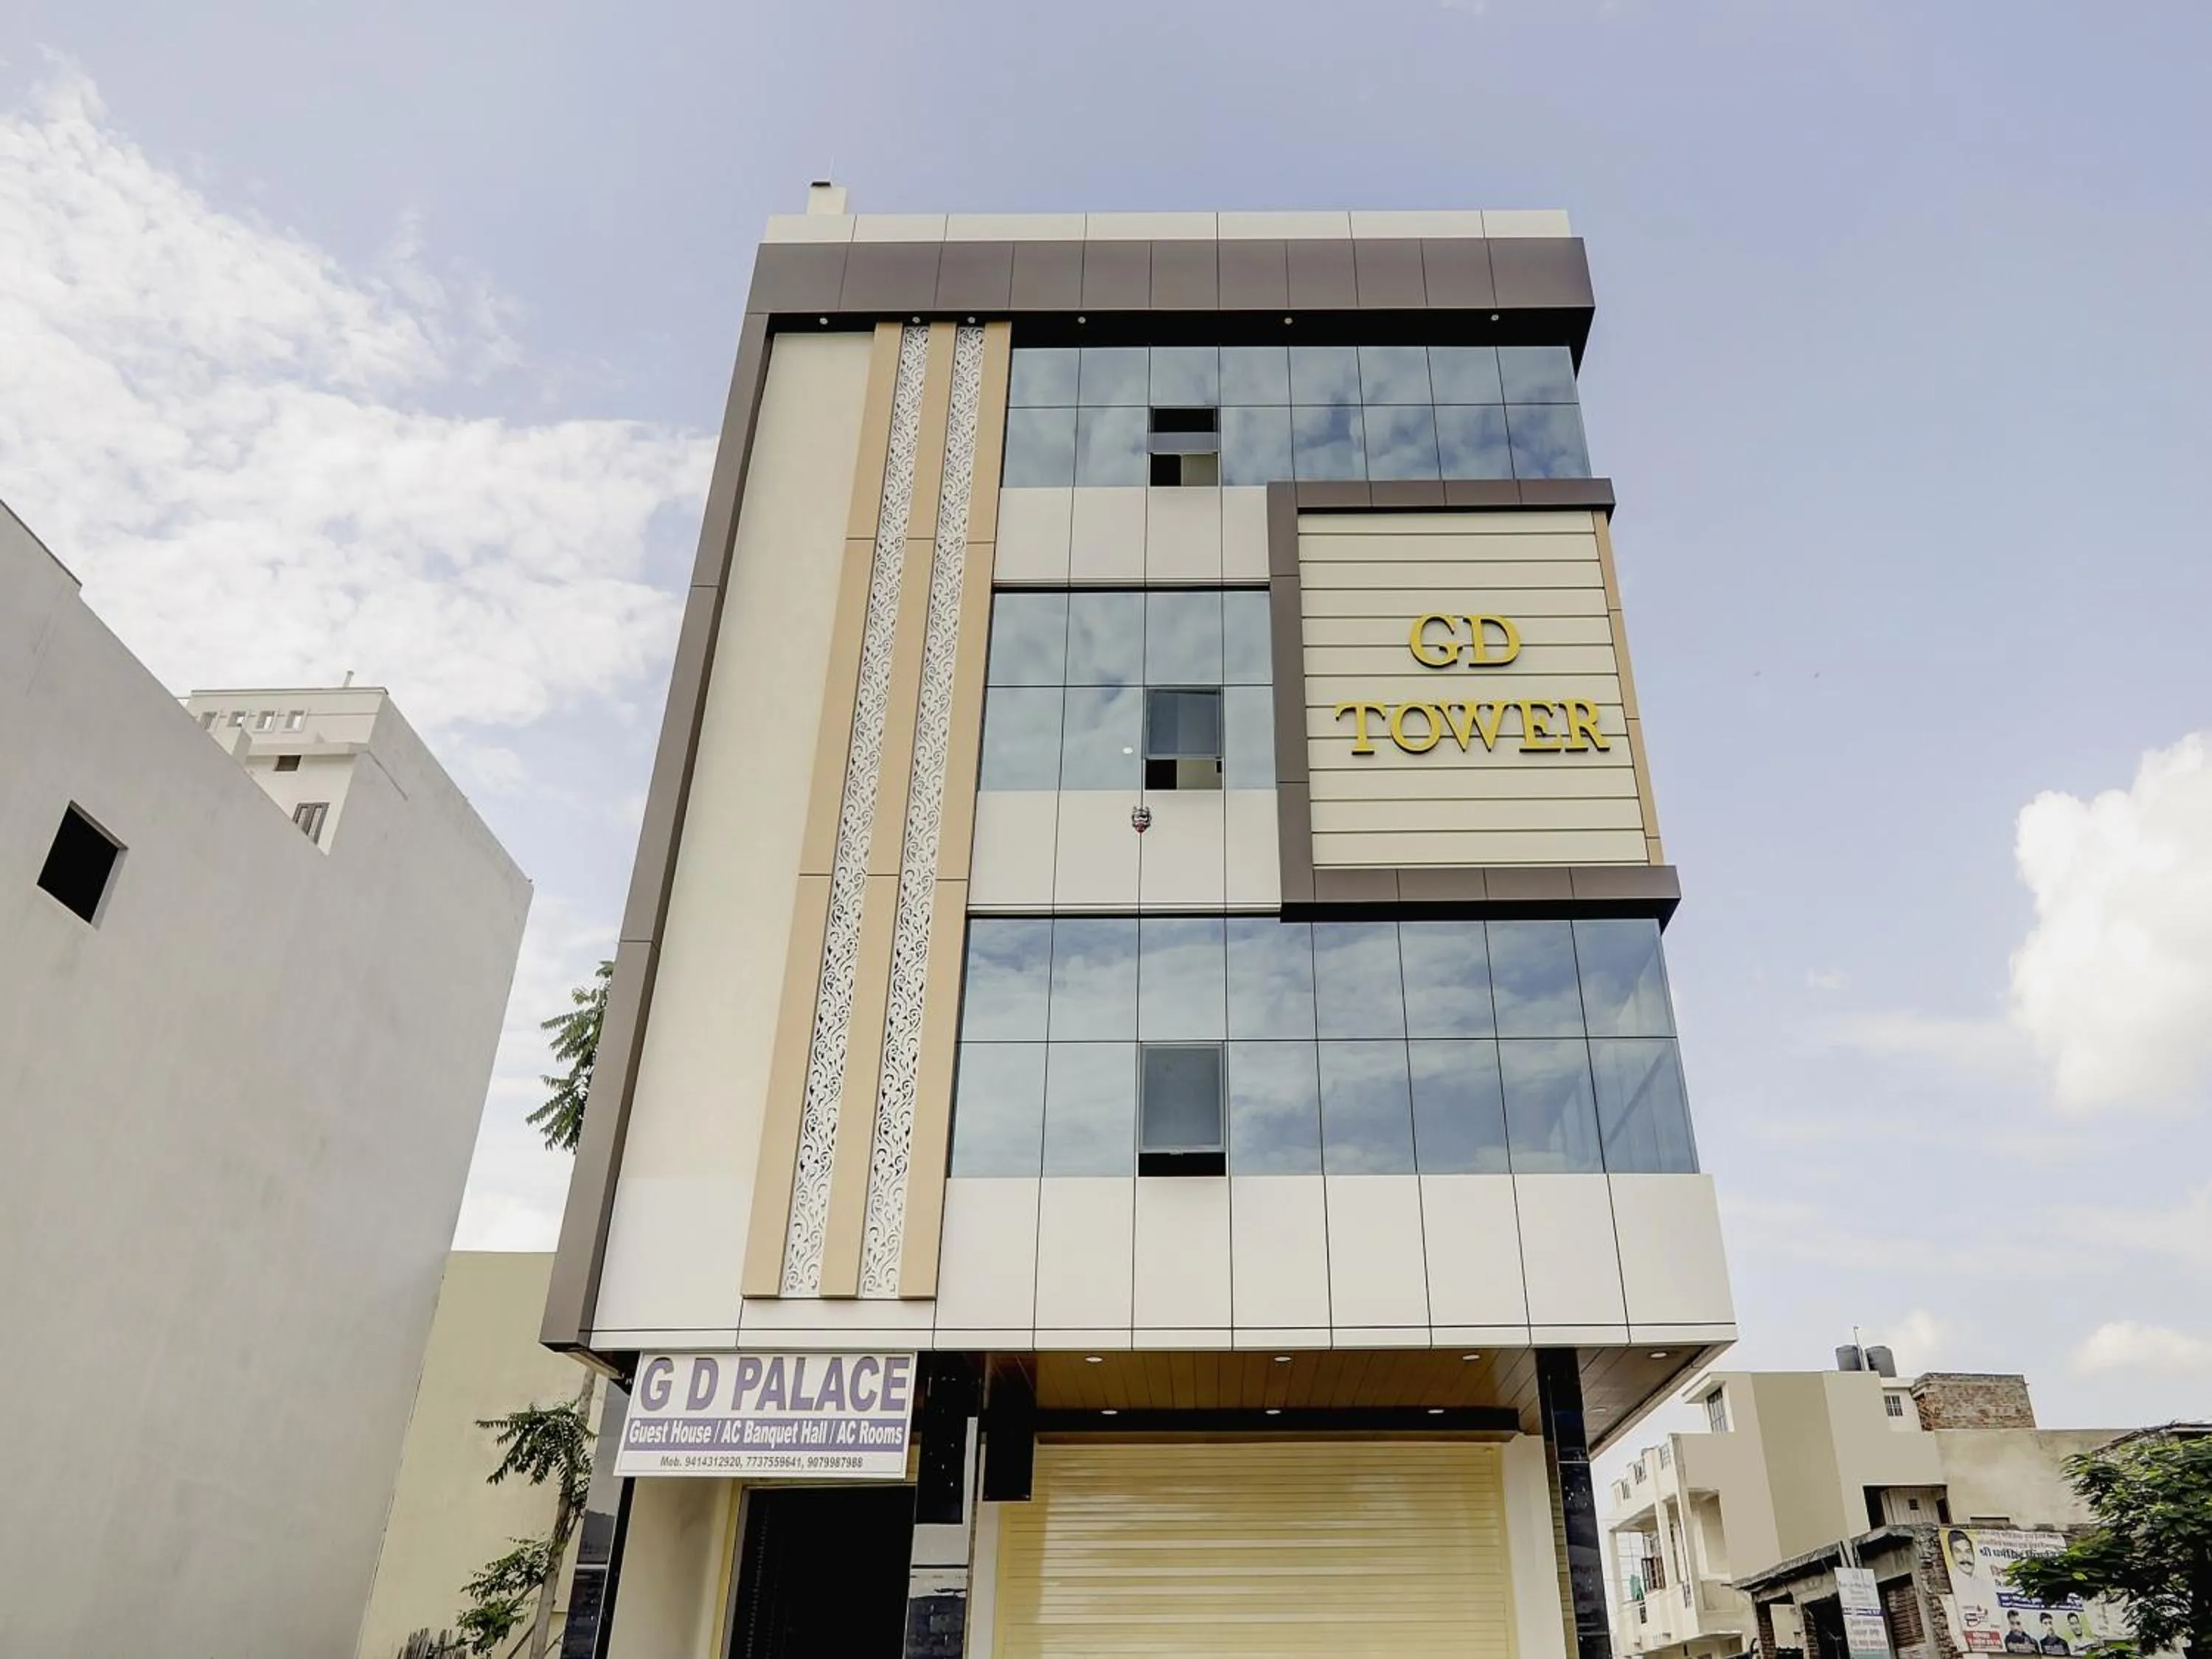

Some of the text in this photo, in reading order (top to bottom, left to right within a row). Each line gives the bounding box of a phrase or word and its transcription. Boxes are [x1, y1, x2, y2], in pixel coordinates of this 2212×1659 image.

[1410, 613, 1521, 668] GD
[1333, 698, 1610, 755] TOWER
[640, 1356, 911, 1412] G D PALACE
[629, 1421, 668, 1444] Guest
[670, 1420, 712, 1444] House
[721, 1421, 742, 1443] AC
[743, 1419, 799, 1448] Banquet
[800, 1420, 827, 1444] Hall
[837, 1422, 857, 1444] AC
[858, 1422, 903, 1445] Rooms
[661, 1456, 682, 1467] Mob.
